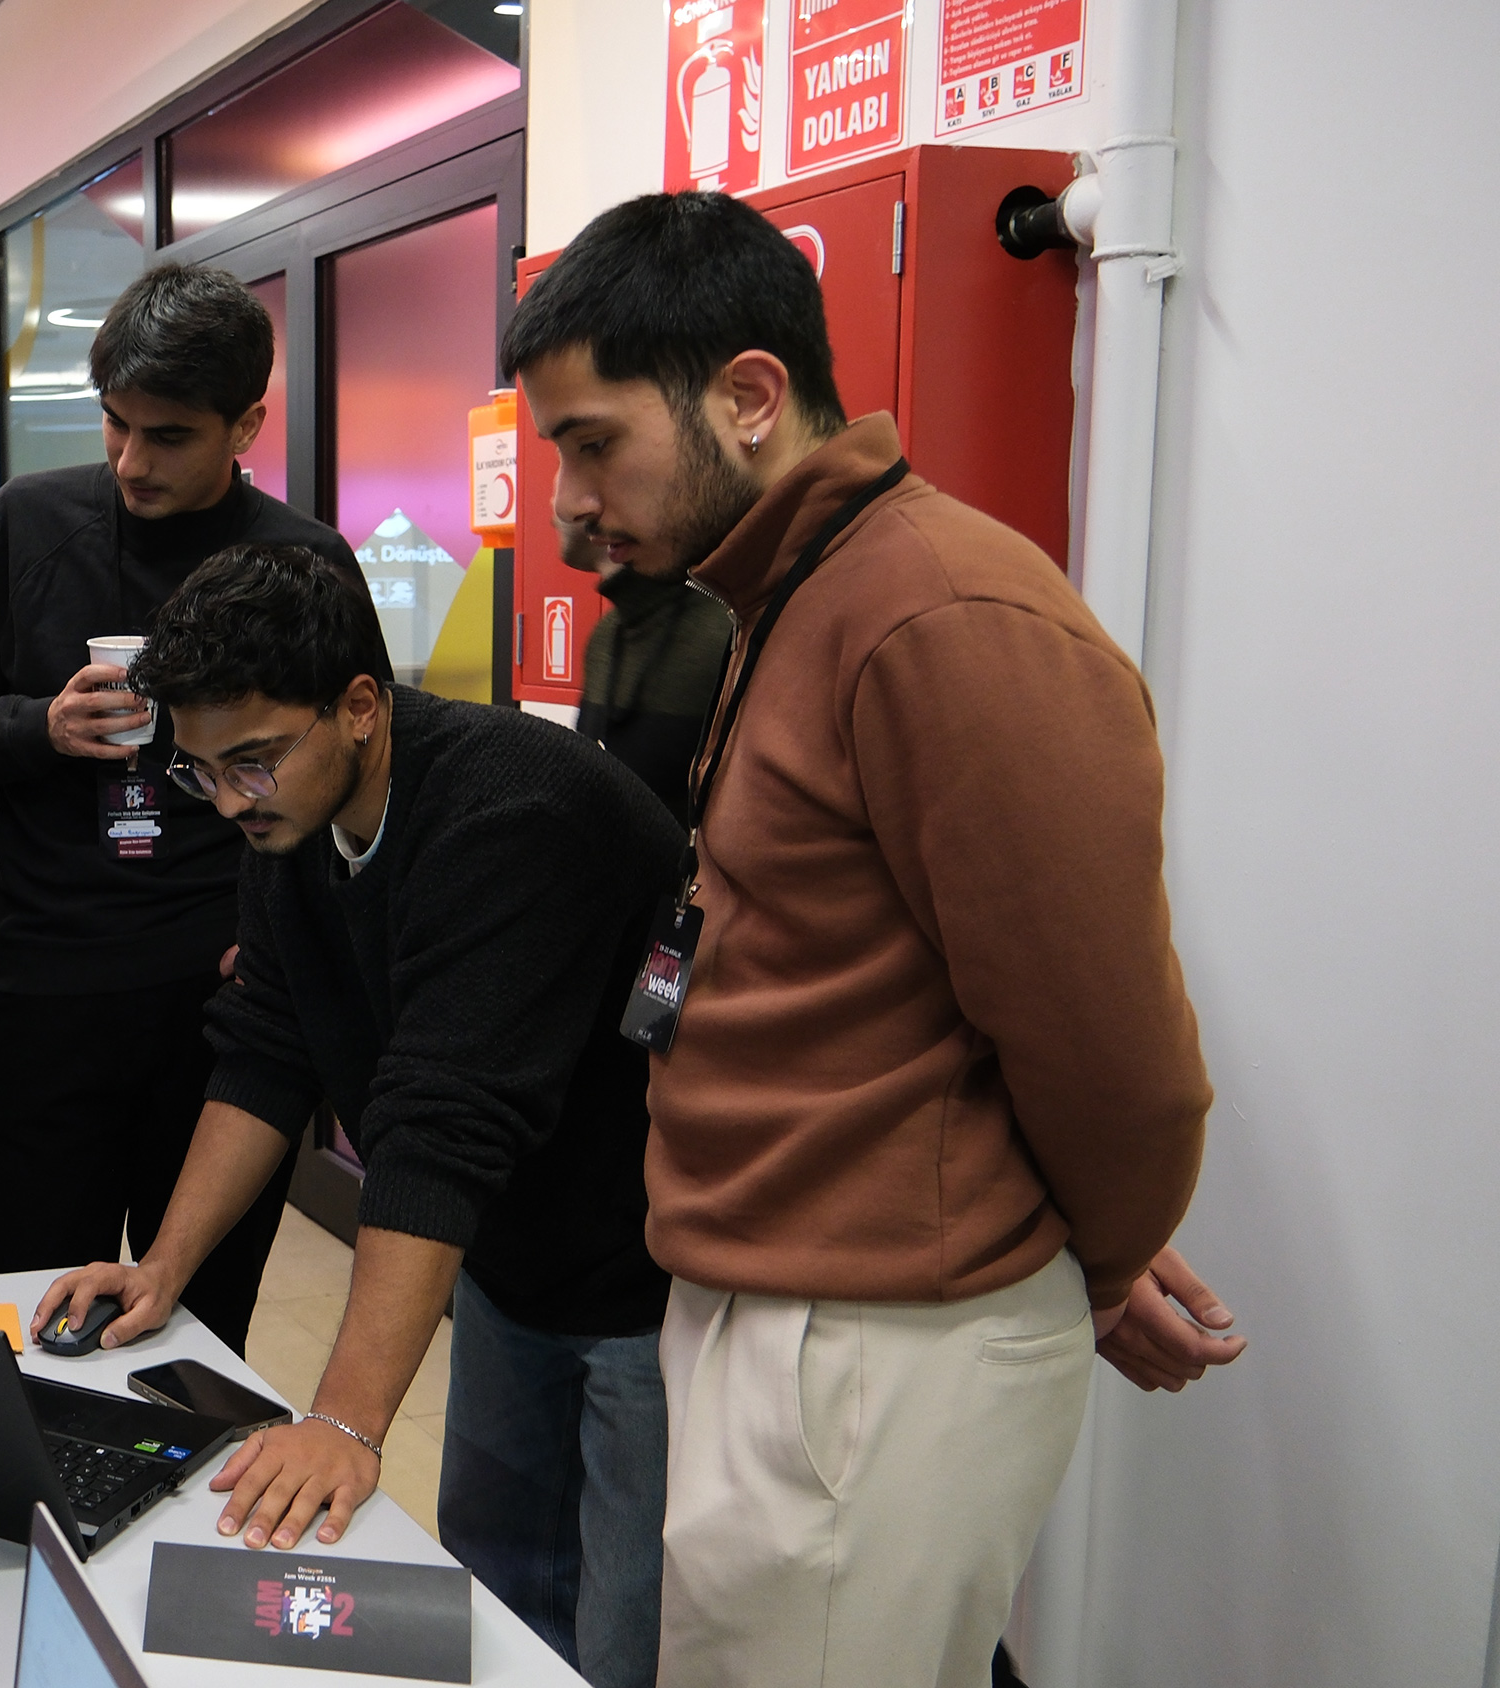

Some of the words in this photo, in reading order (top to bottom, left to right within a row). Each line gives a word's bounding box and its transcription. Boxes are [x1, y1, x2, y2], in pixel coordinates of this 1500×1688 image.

[1062, 52, 1070, 68] F
[804, 38, 890, 101] YANGIN
[1026, 65, 1034, 78] C
[991, 77, 998, 89] B
[956, 88, 964, 100] A
[1016, 97, 1031, 108] GAZ
[802, 91, 888, 152] DOLABI
[648, 972, 681, 1003] week
[298, 1573, 316, 1582] Week
